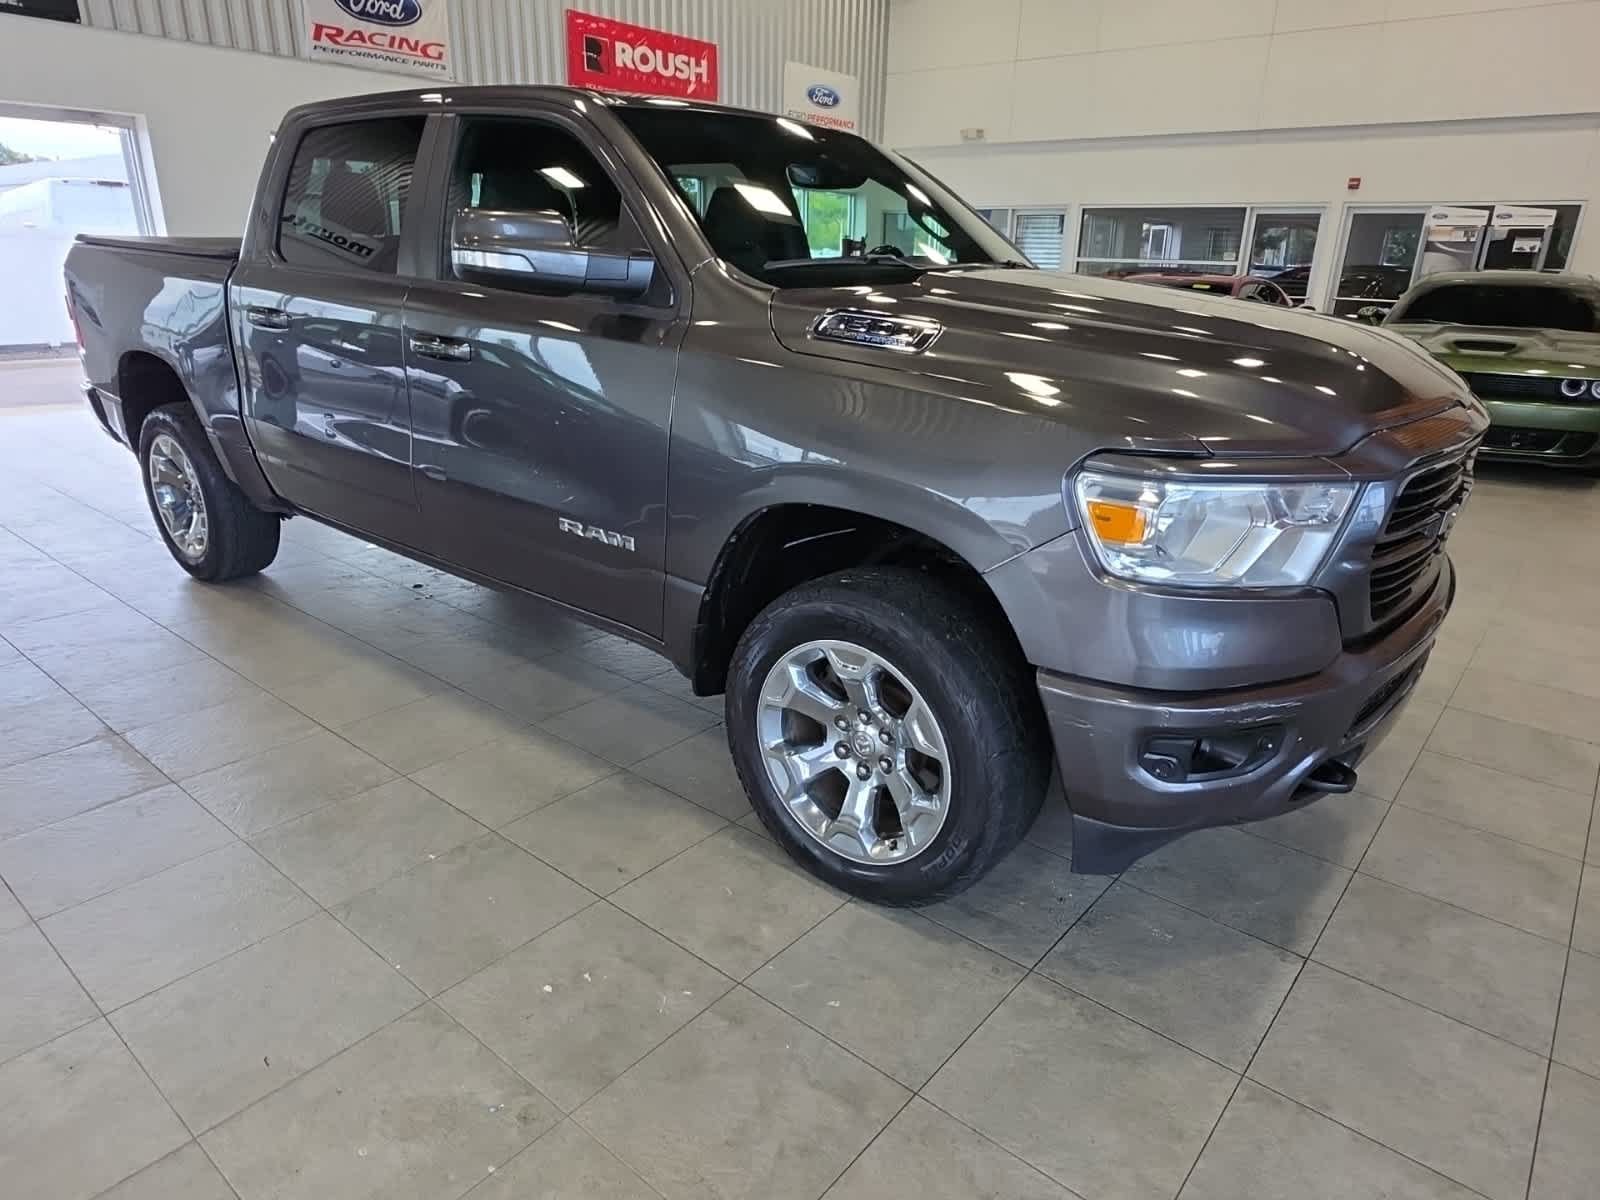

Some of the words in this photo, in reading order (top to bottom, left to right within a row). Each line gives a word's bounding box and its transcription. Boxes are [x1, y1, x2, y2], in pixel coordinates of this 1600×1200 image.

[312, 23, 446, 61] RACING
[313, 44, 410, 65] PERFORMANCE
[412, 59, 447, 71] PARTS
[614, 40, 709, 84] ROUSH
[812, 86, 835, 106] Ford
[558, 516, 636, 552] RAM
